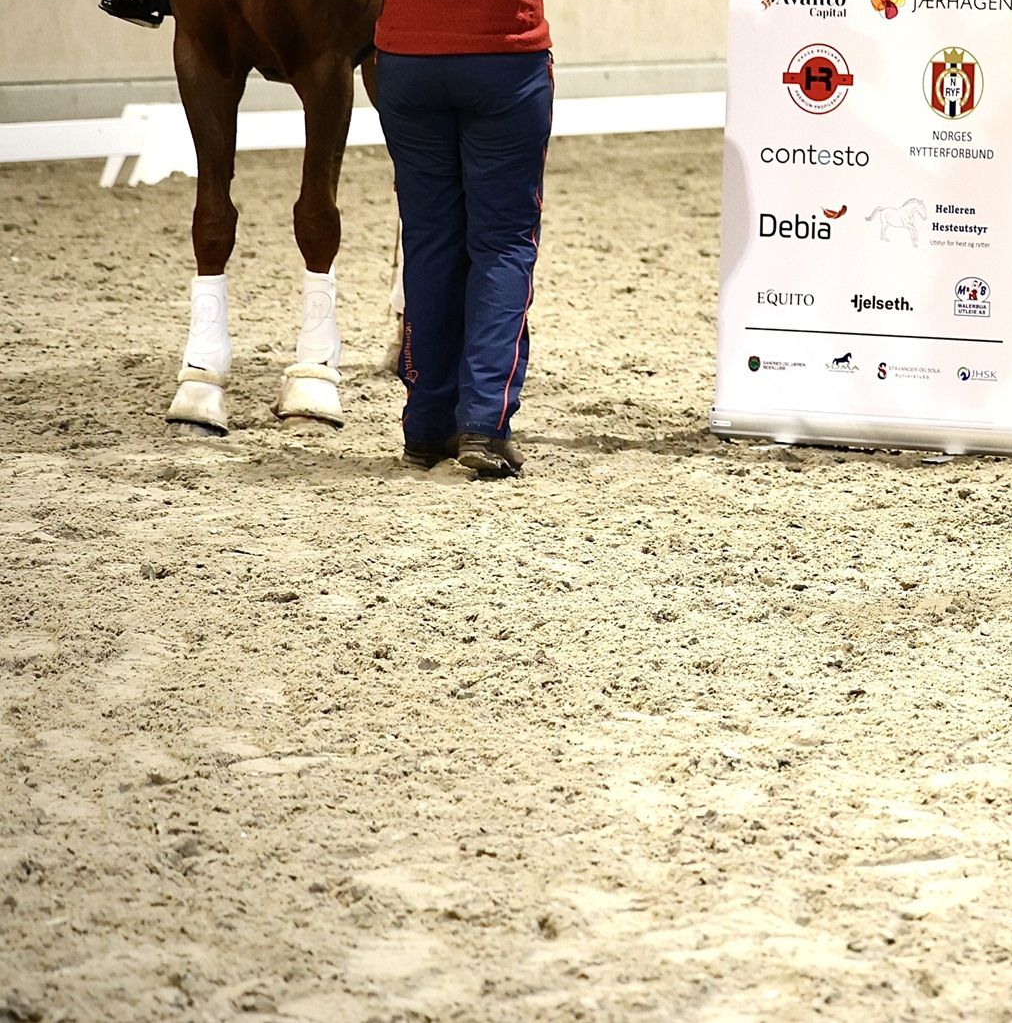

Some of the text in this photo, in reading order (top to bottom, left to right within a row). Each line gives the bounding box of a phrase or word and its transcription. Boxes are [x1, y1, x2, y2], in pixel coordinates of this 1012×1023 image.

[809, 7, 847, 19] Capital
[950, 78, 957, 87] N
[945, 88, 961, 97] RYF
[933, 131, 972, 141] NORGES
[761, 145, 869, 166] contesto
[910, 147, 993, 159] RYTTERFORBUND
[936, 205, 975, 214] Helleren
[759, 213, 831, 240] Debia
[932, 223, 987, 235] Hesteutstyr
[758, 290, 814, 306] EQUITO
